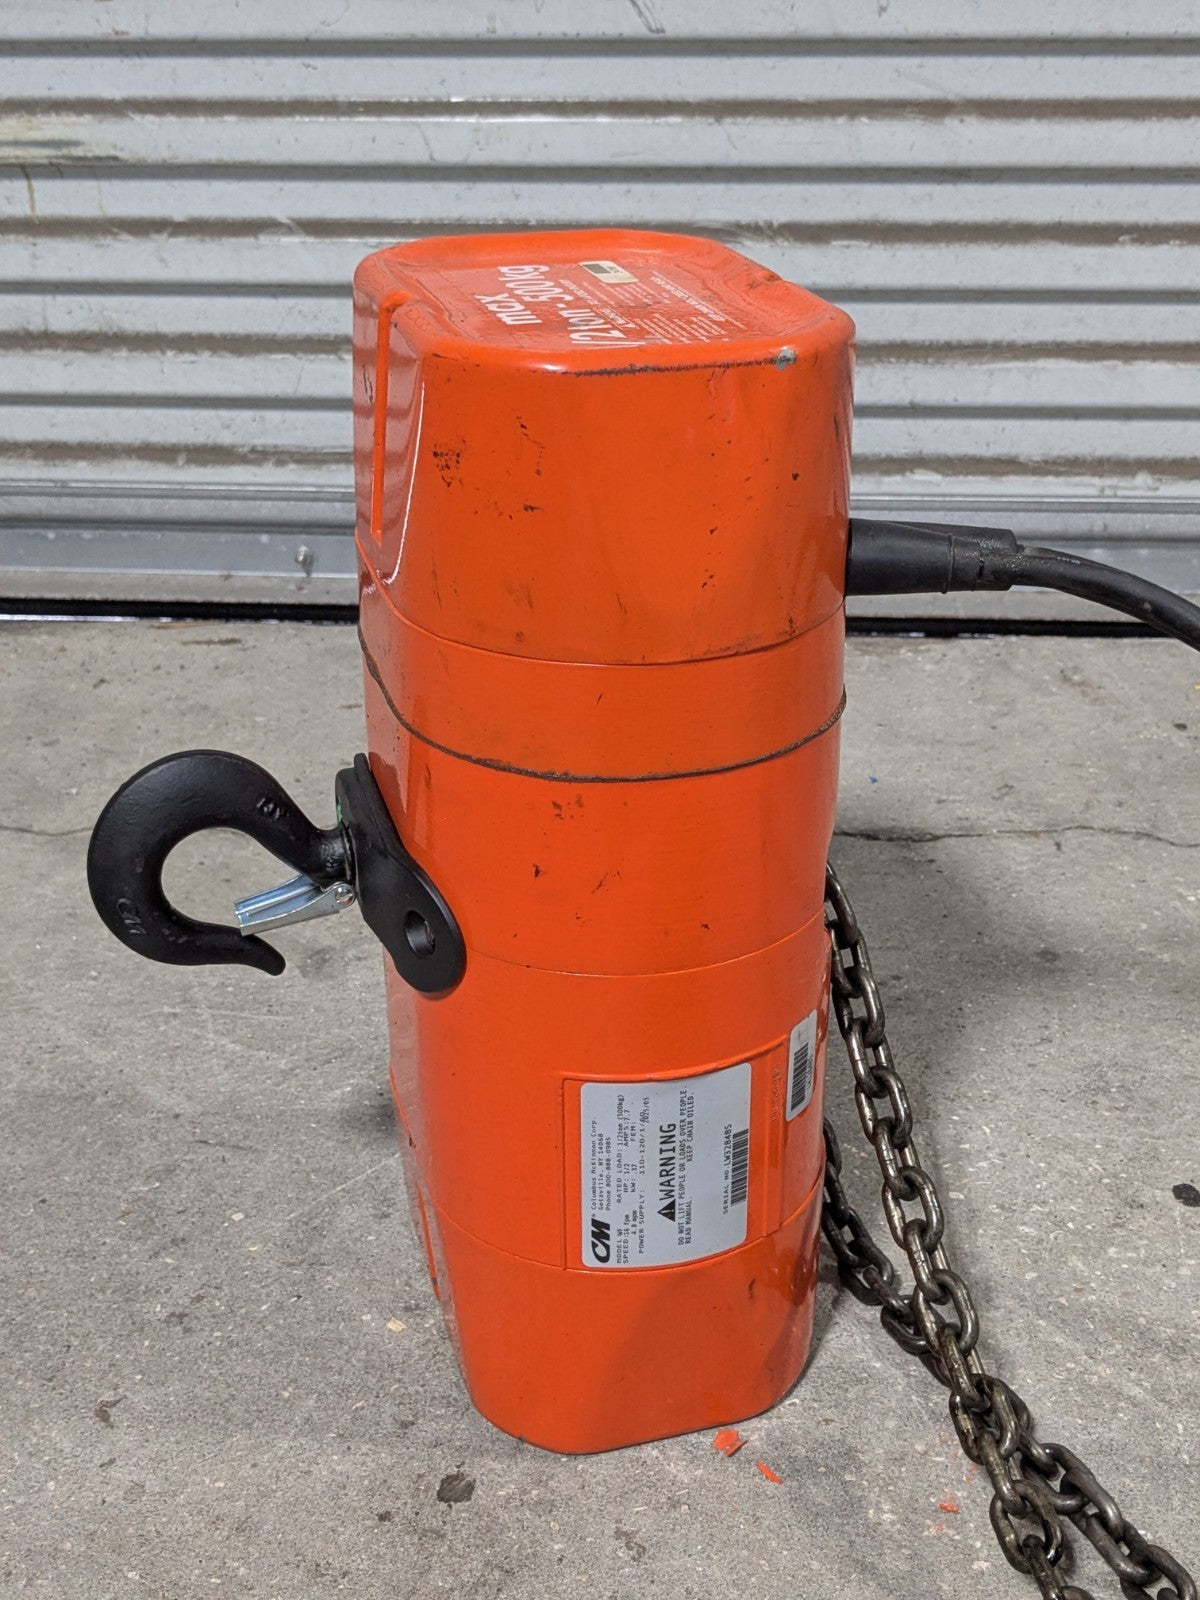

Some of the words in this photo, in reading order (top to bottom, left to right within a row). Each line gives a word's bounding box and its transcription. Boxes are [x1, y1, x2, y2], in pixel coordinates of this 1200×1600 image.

[475, 292, 542, 325] max
[557, 308, 613, 330] ton
[617, 1095, 625, 1120] (500kg)
[590, 1117, 598, 1138] Corp.
[659, 1123, 676, 1201] WARNING
[686, 1145, 694, 1162] KEEP
[591, 1218, 610, 1263] CM
